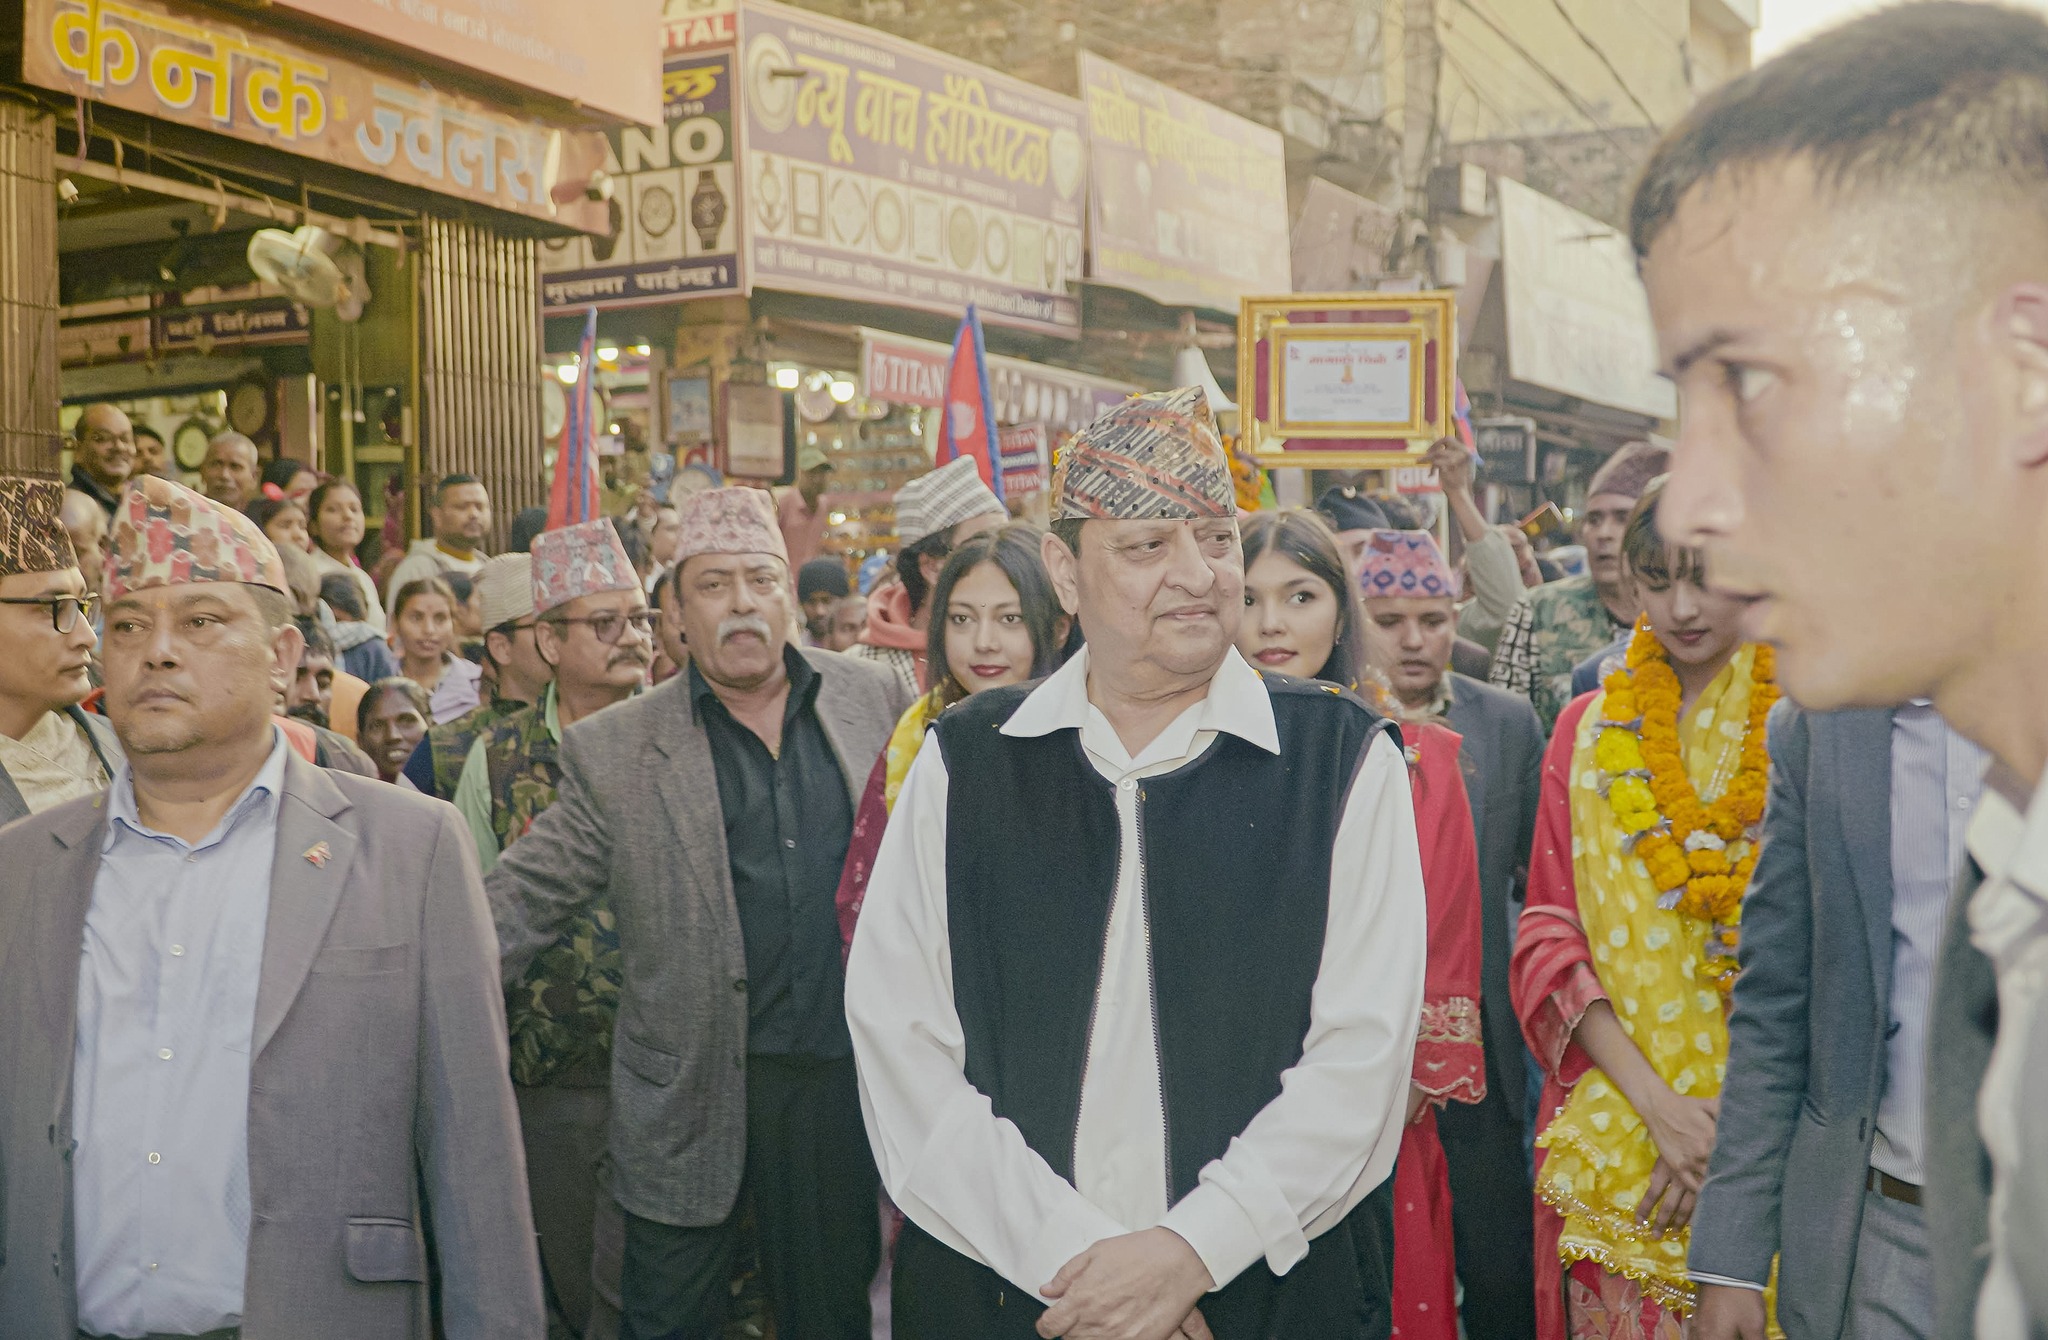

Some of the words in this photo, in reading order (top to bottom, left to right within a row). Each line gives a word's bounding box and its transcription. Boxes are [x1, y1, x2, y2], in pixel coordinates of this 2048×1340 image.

[661, 16, 735, 50] ITAL
[52, 0, 331, 141] कनक
[662, 64, 724, 103] ल
[796, 53, 855, 165] न्यू
[855, 69, 922, 154] वाच
[886, 355, 945, 400] TITAN
